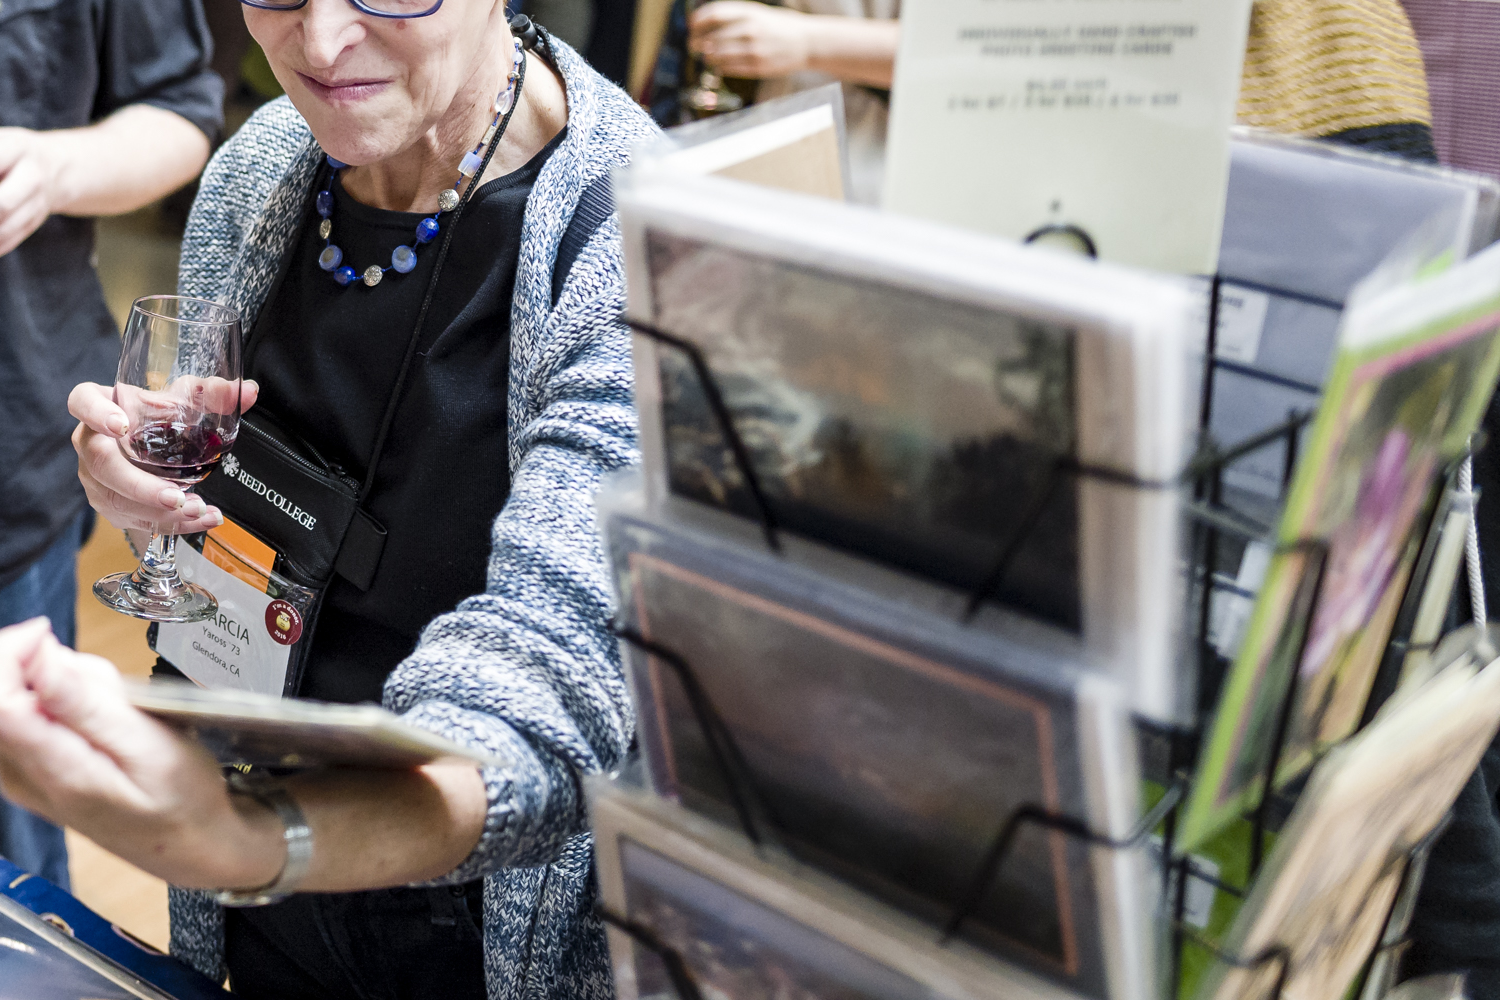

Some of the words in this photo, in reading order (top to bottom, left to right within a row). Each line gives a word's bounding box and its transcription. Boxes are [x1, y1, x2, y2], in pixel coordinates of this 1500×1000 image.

[237, 468, 267, 496] REED
[266, 489, 317, 531] COLLEGE
[202, 626, 227, 648] Yaross
[208, 613, 250, 646] ARCIA
[192, 641, 228, 671] Glendora,
[229, 664, 241, 678] CA
